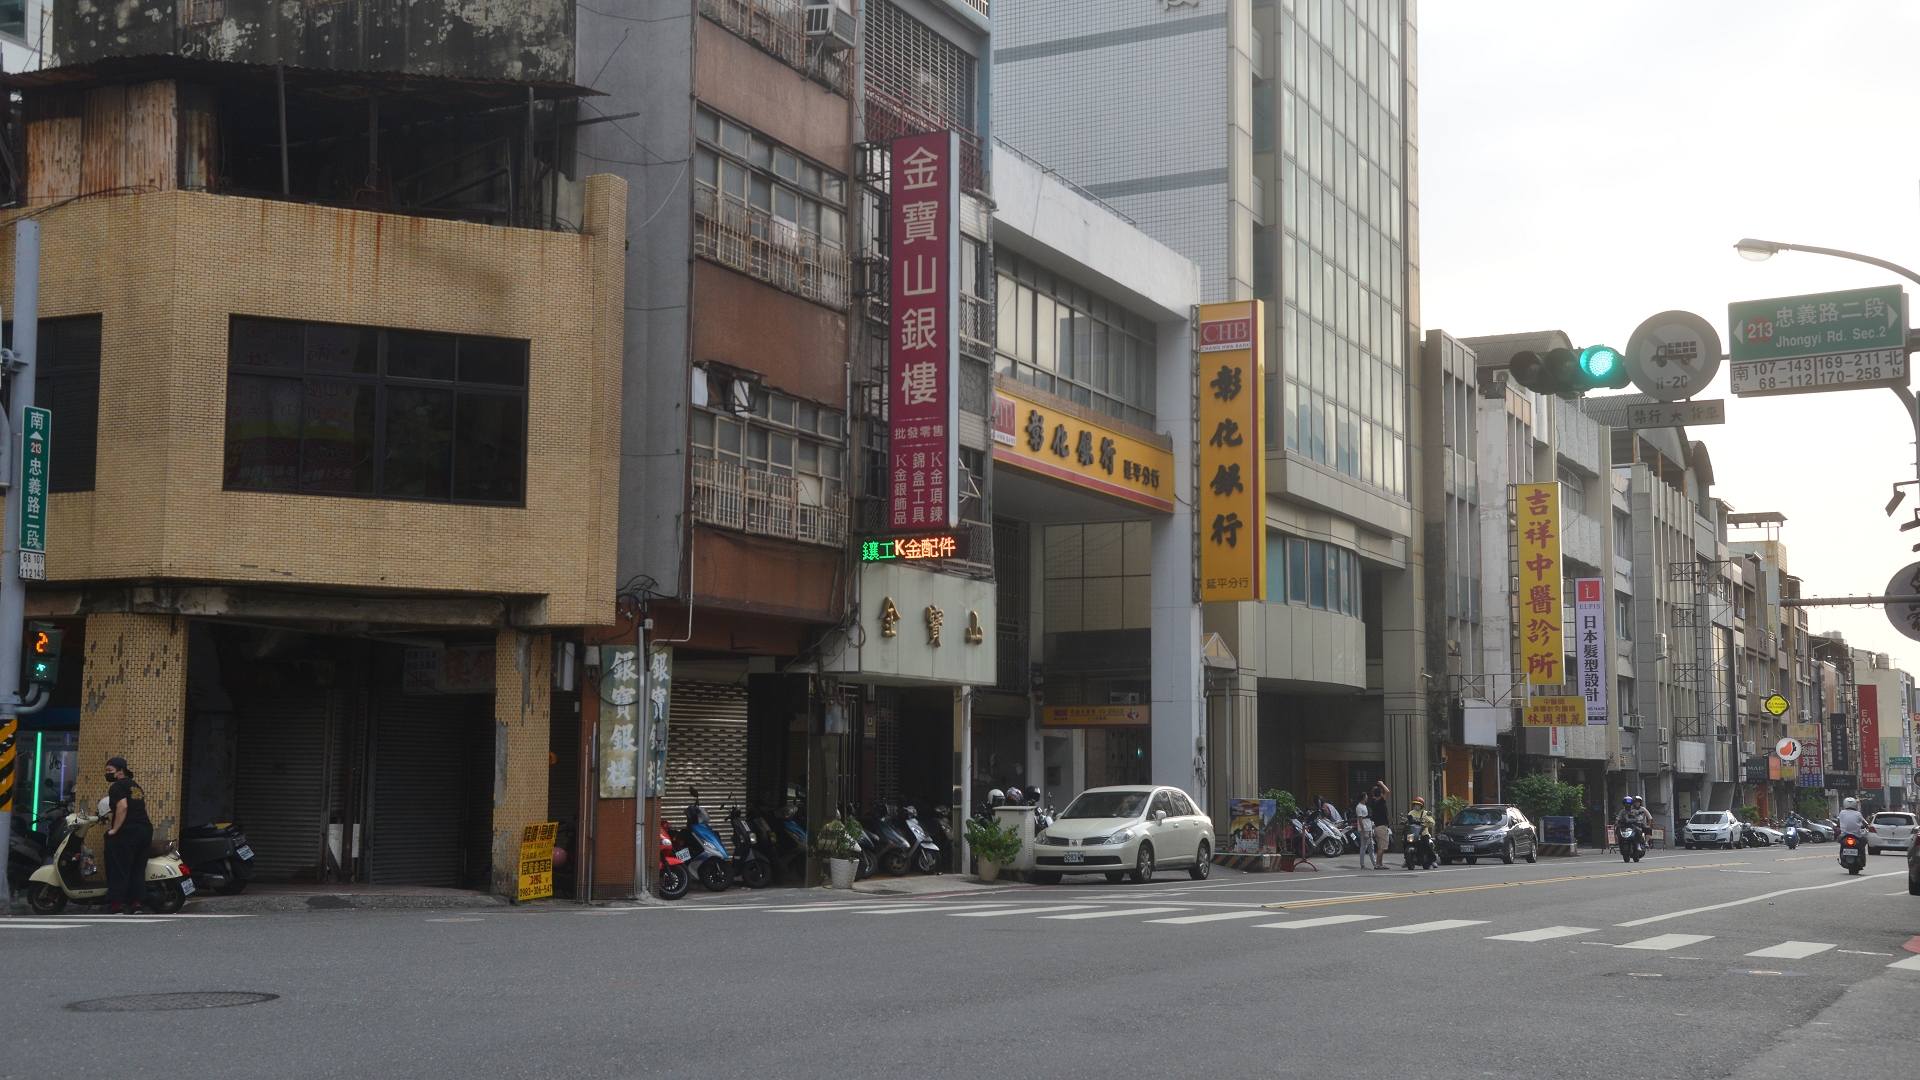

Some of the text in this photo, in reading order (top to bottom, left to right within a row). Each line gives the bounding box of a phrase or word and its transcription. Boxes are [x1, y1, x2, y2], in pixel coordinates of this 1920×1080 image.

[902, 146, 938, 405] 金寶山銀樓
[1747, 298, 1884, 339] 213 忠義路二段
[1204, 322, 1248, 343] CHB
[1776, 326, 1886, 347] Jhongyi Rd. Sec.2
[1752, 359, 1812, 376] 107-143
[1818, 352, 1880, 370] 169-211
[1885, 351, 1903, 366] 北
[1733, 366, 1749, 381] 南
[1759, 374, 1813, 390] 68-112
[1820, 367, 1881, 383] 170-258
[1892, 367, 1903, 376] N.
[31, 412, 44, 430] 南
[894, 425, 943, 440] 批發零售
[1026, 409, 1116, 475] 彰化銀行
[31, 442, 41, 454] 213
[1210, 365, 1244, 548] 彰化銀行
[894, 454, 907, 525] K金銀飾品
[912, 452, 925, 523] 錦盒工具
[930, 451, 943, 522] K金項鍊
[27, 458, 42, 546] 忠義路二段
[862, 536, 956, 561] 鑲工K金配件
[1206, 577, 1249, 589] 延平分行
[1524, 488, 1560, 678] 吉祥中醫診所
[878, 596, 984, 648] 金寶山
[36, 632, 49, 653] 2
[1583, 615, 1599, 702] 日本髮型設計
[606, 651, 639, 789] 銀寶銀樓
[1528, 713, 1582, 725] 林周雅麗
[1861, 710, 1872, 734] EMC
